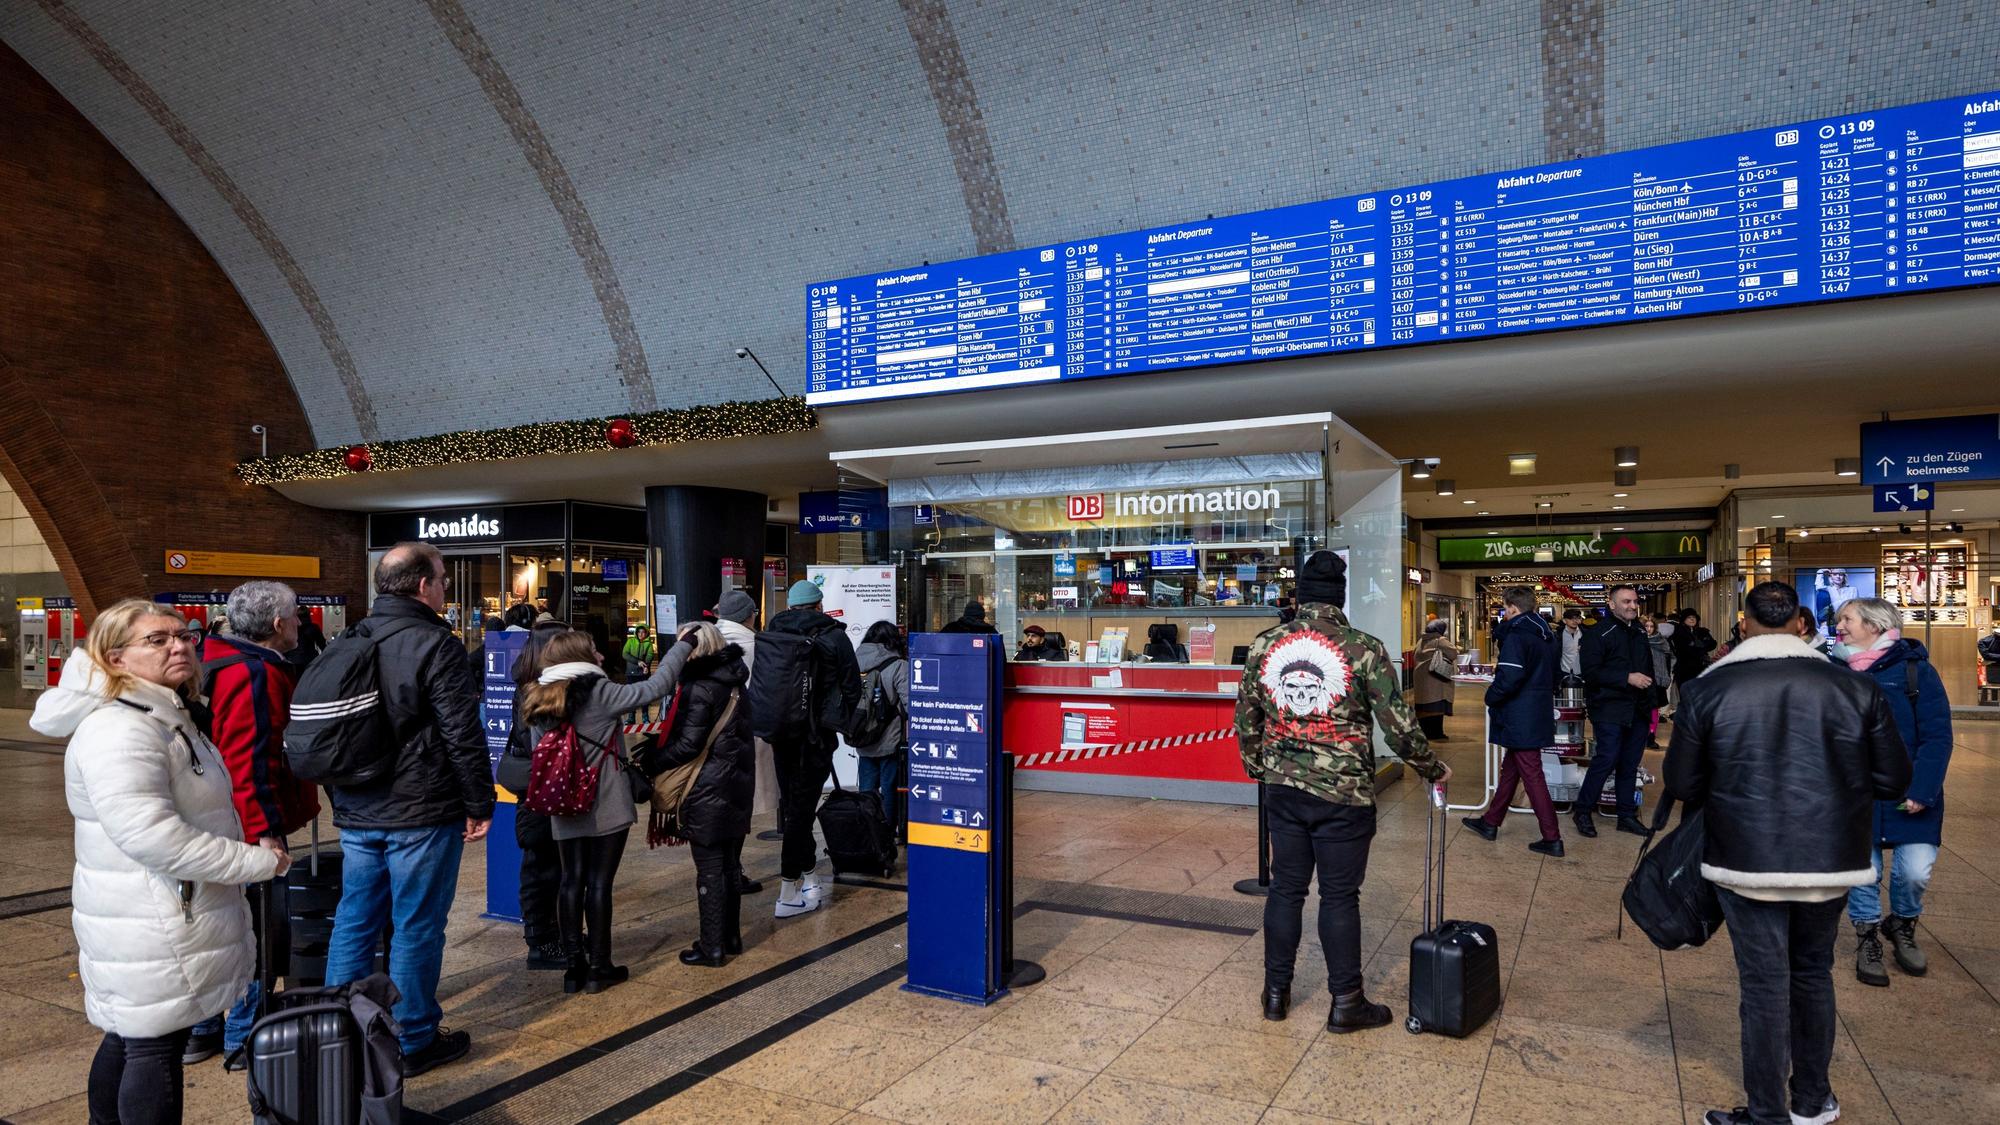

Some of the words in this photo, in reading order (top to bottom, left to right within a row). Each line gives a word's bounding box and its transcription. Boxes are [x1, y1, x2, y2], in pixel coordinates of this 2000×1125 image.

[1840, 122, 1854, 135] 13
[1858, 119, 1874, 131] 09
[1776, 130, 1797, 146] DB
[1906, 148, 1916, 156] RE
[1821, 157, 1849, 170] 14:21
[1497, 175, 1534, 189] Abfahrt
[1535, 168, 1582, 183] Departure
[1821, 172, 1850, 185] 14:24
[1906, 179, 1916, 187] RB
[1918, 178, 1928, 186] 27
[1406, 192, 1417, 203] 13
[1419, 190, 1432, 201] 09
[1633, 185, 1678, 198] Köln/Bonn
[1821, 188, 1849, 201] 14:25
[1906, 195, 1916, 203] RE
[1924, 191, 1946, 202] (RRX)
[1359, 198, 1374, 212] DB
[1633, 200, 1672, 212] München
[1673, 195, 1689, 206] Hbf
[1633, 206, 1718, 226] Frankfurt(Main)Hbf
[1821, 204, 1849, 216] 14:31
[1906, 211, 1916, 219] RE
[1924, 207, 1946, 218] (RRX)
[1392, 222, 1413, 233] 13:52
[1821, 219, 1850, 232] 14:32
[1906, 227, 1917, 235] RB
[1147, 232, 1176, 244] Abfahrt
[1177, 227, 1212, 239] Departure
[1392, 235, 1413, 246] 13:55
[1633, 231, 1658, 241] Düren
[1821, 234, 1850, 247] 14:36
[1077, 245, 1086, 254] 13
[1088, 243, 1098, 253] 09
[1251, 241, 1296, 254] Bonn-Mehlem
[1633, 246, 1645, 256] Au
[1647, 242, 1673, 256] (Sieg)
[1042, 250, 1053, 260] DB
[1251, 254, 1270, 266] Essen
[1270, 252, 1283, 263] Hbf
[1392, 249, 1413, 260] 13:59
[1821, 250, 1850, 263] 14:37
[1392, 262, 1414, 273] 14:00
[1633, 261, 1655, 270] Bonn
[1656, 257, 1672, 267] Hbf
[1906, 259, 1916, 267] RE
[1067, 271, 1084, 281] 13:36
[1251, 263, 1299, 279] Leer(Ostfriesl)
[1633, 274, 1664, 285] Minden
[1667, 268, 1700, 282] (Westf)
[1821, 266, 1850, 278] 14:42
[876, 276, 899, 286] Abfahrt
[899, 273, 928, 283] Departure
[1392, 276, 1413, 287] 14:01
[1906, 275, 1917, 283] RB
[1918, 274, 1928, 282] 24
[821, 286, 828, 295] 13
[828, 285, 837, 294] 09
[971, 286, 981, 295] Hbf
[1067, 283, 1084, 292] 13:37
[1251, 281, 1276, 292] Koblenz
[1277, 279, 1290, 288] Hbf
[1821, 281, 1850, 294] 14:47
[1251, 293, 1275, 304] Krefeld
[1275, 290, 1288, 301] Hbf
[1392, 289, 1413, 300] 14:07
[1633, 285, 1704, 299] Hamburg-Altona
[957, 297, 976, 308] Aachen
[976, 295, 986, 305] Hbf
[1067, 294, 1084, 304] 13:37
[1067, 306, 1084, 316] 13:38
[1251, 307, 1264, 317] Kall
[1392, 302, 1413, 313] 14:07
[1633, 303, 1664, 314] Aachen
[1666, 300, 1682, 310] Hbf
[957, 320, 975, 330] Rheine
[1067, 318, 1084, 328] 13:42
[1251, 321, 1272, 330] Hamm
[1273, 316, 1298, 328] (Westf)
[1299, 314, 1312, 324] Hbf
[1392, 316, 1413, 326] 14:11
[957, 332, 972, 342] Essen
[972, 330, 982, 339] Hbf
[1067, 330, 1084, 339] 13:46
[1251, 333, 1275, 342] Aachen
[1276, 330, 1288, 339] Hbf
[1392, 329, 1413, 340] 14:15
[957, 343, 969, 352] Köln
[969, 340, 995, 351] Hansaring
[1067, 341, 1084, 351] 13:49
[1251, 340, 1328, 355] Wuppertal-Oberbarmen
[957, 351, 1017, 365] Wuppertal-Oberbarmen
[1067, 353, 1084, 363] 13:49
[957, 365, 978, 375] Koblenz
[978, 364, 988, 374] Hbf
[1067, 365, 1084, 374] 13:52
[1923, 454, 1944, 463] den
[1947, 452, 1982, 463] Zügen
[1906, 465, 1970, 476] koelnmesse
[1908, 483, 1919, 502] 1
[1069, 494, 1103, 518] DB
[1115, 487, 1280, 516] Information
[827, 514, 846, 523] Lounge
[418, 513, 500, 539] Leonidas
[1484, 541, 1514, 558] ZUG
[1563, 539, 1605, 557] MAC.
[1113, 562, 1120, 578] 1
[935, 701, 984, 711] Fahrkartenverkauf
